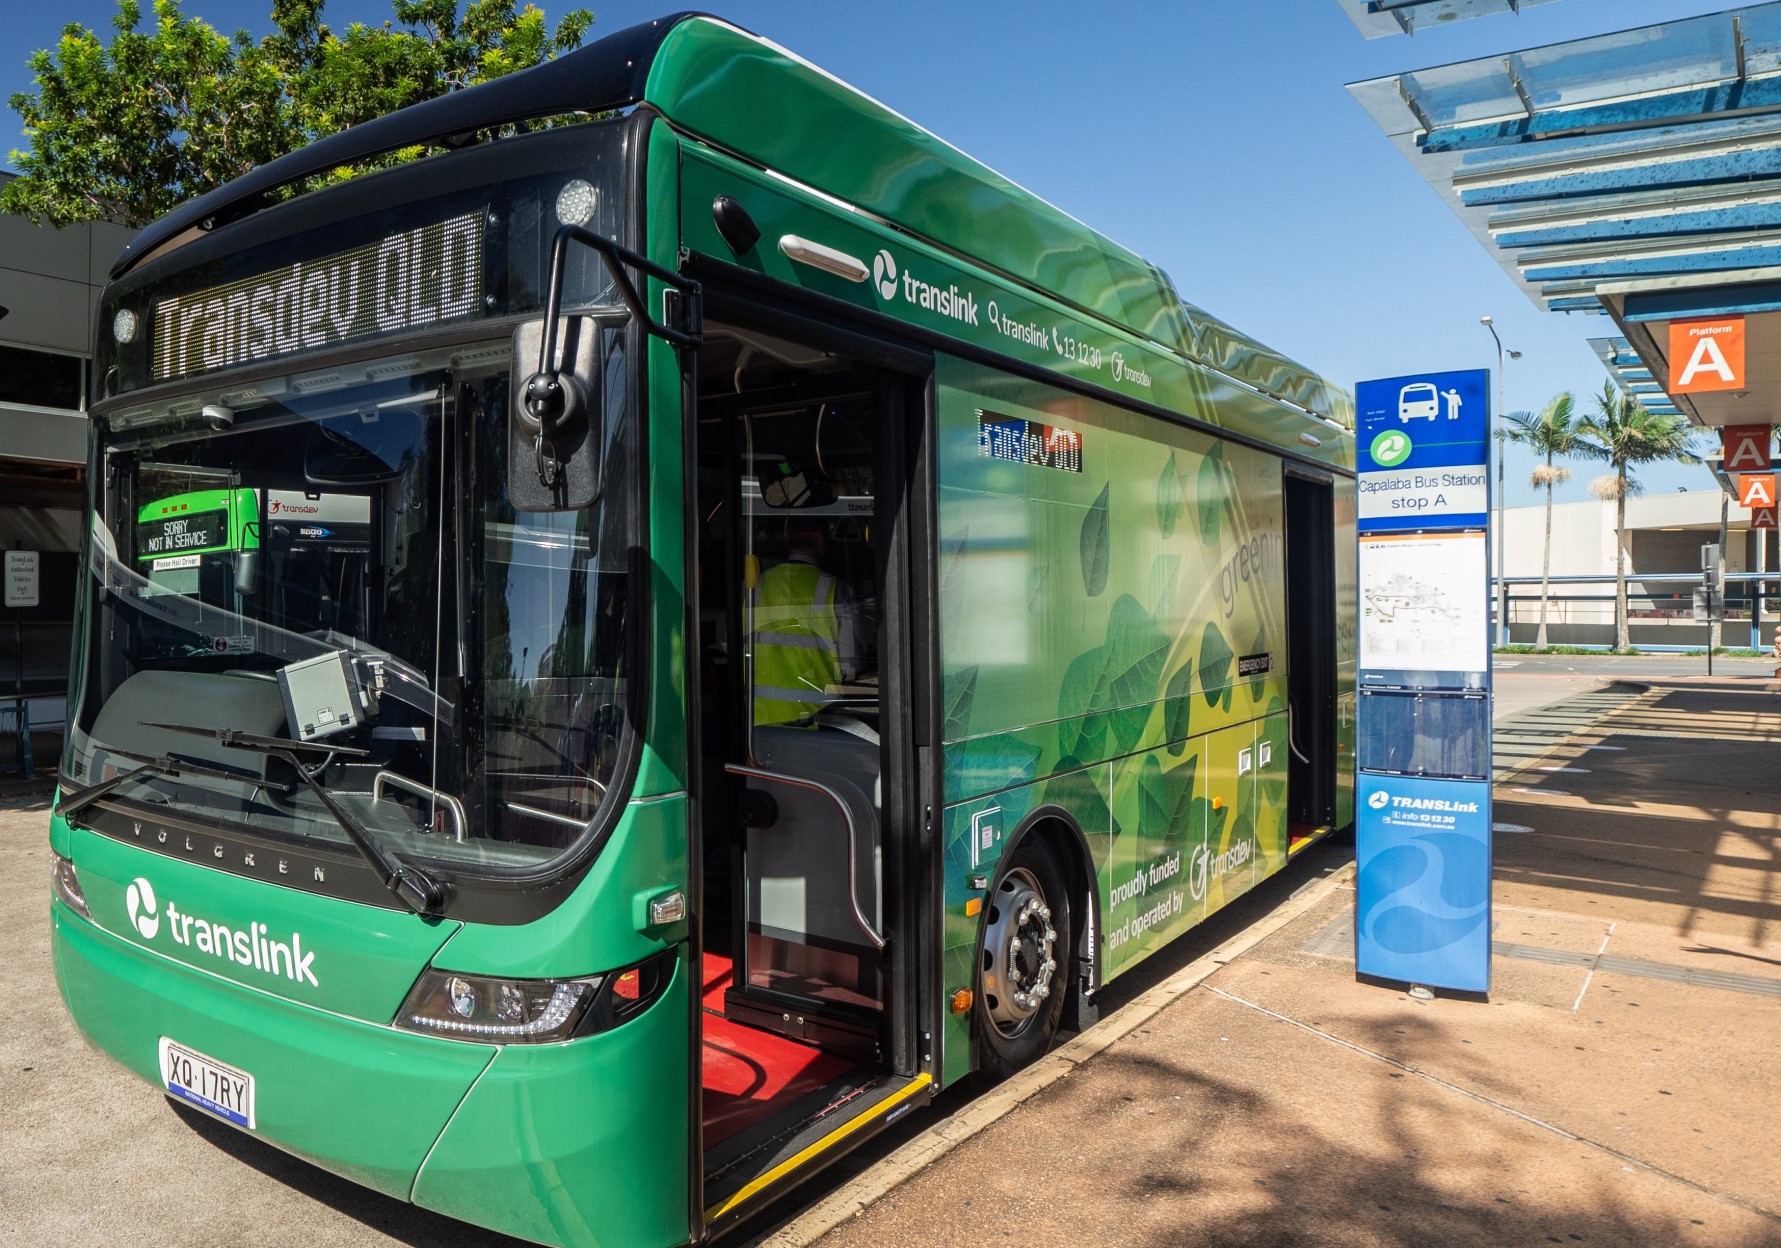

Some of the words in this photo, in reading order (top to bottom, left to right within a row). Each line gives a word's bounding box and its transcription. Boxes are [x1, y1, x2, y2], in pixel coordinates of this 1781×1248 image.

[155, 261, 360, 378] Transdev
[377, 213, 477, 332] QLD
[902, 269, 978, 326] translink
[1002, 313, 1049, 350] translink
[1063, 336, 1075, 360] 13
[1078, 342, 1089, 365] 12
[1089, 348, 1102, 370] 30
[1689, 326, 1732, 336] Platform
[1677, 337, 1735, 386] A
[1124, 363, 1152, 388] transdev
[1729, 438, 1765, 467] A
[1359, 478, 1411, 494] Capalaba
[1415, 476, 1439, 488] Bus
[1442, 473, 1486, 487] Station
[1743, 481, 1771, 505] A
[282, 504, 319, 513] transdev
[1391, 497, 1428, 510] stop
[1434, 494, 1447, 506] A
[163, 519, 189, 536] SORRY
[1754, 508, 1776, 526] A
[148, 537, 164, 552] NOT
[165, 536, 173, 550] IN
[175, 531, 208, 548] SERVICE
[182, 558, 197, 566] Driver
[16, 586, 28, 594] Only
[1392, 797, 1479, 813] TRANSLink
[1402, 812, 1418, 821] info
[132, 821, 326, 883] VOLGREN
[1210, 838, 1252, 880] transdev
[1110, 867, 1148, 913] proudly
[1149, 850, 1180, 887] funded
[1110, 917, 1129, 950] and
[1131, 896, 1171, 939] operated
[1173, 890, 1184, 914] by
[166, 901, 319, 987] translink
